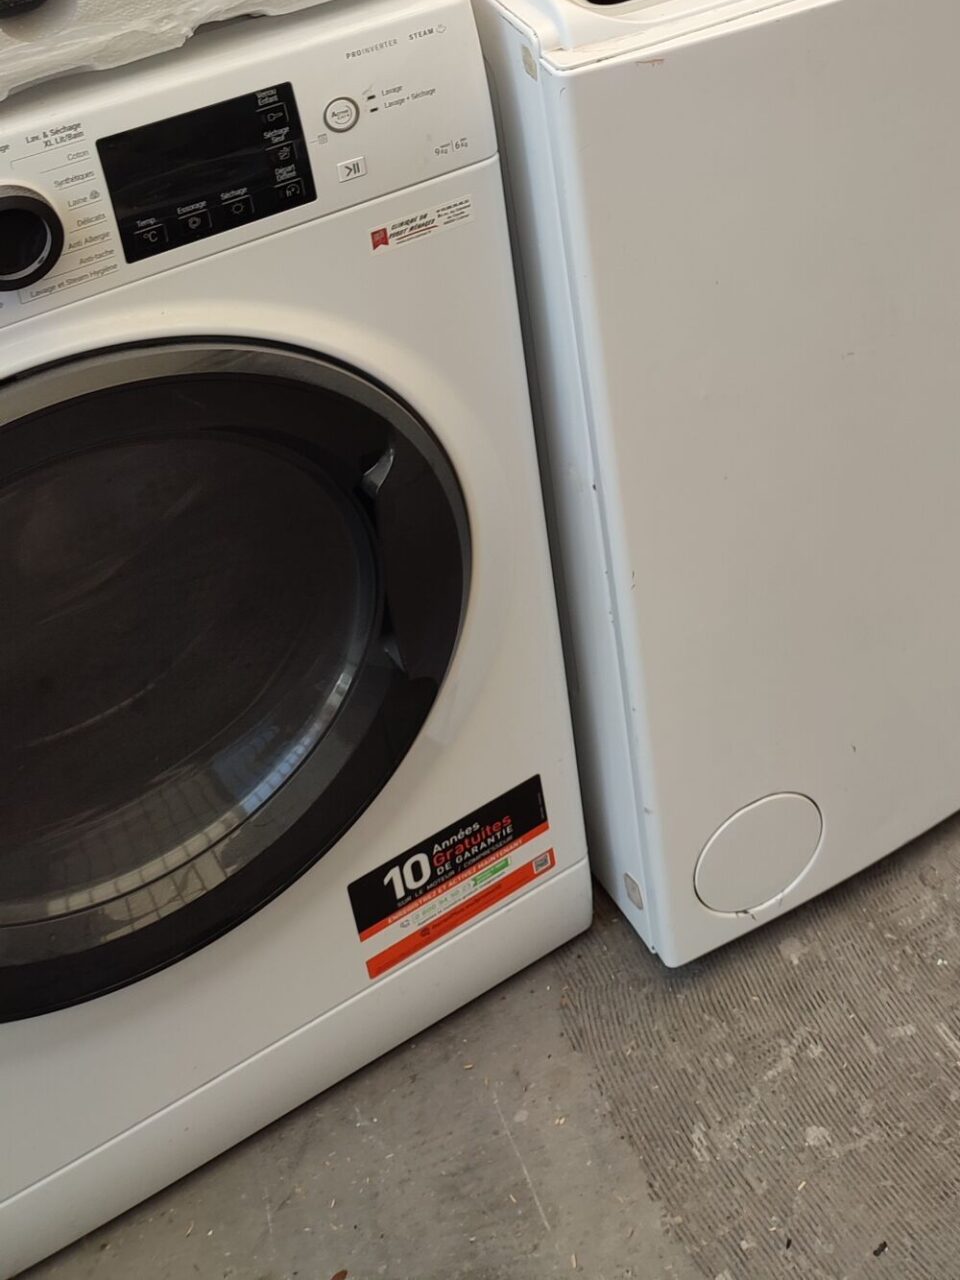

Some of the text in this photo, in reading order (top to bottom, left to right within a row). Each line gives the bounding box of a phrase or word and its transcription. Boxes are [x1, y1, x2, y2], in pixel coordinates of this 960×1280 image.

[408, 27, 434, 40] STEAM
[432, 821, 480, 855] Années
[432, 815, 512, 868] Gratuites
[436, 862, 452, 877] DE
[455, 823, 514, 864] GARANTIE
[383, 852, 431, 900] 10
